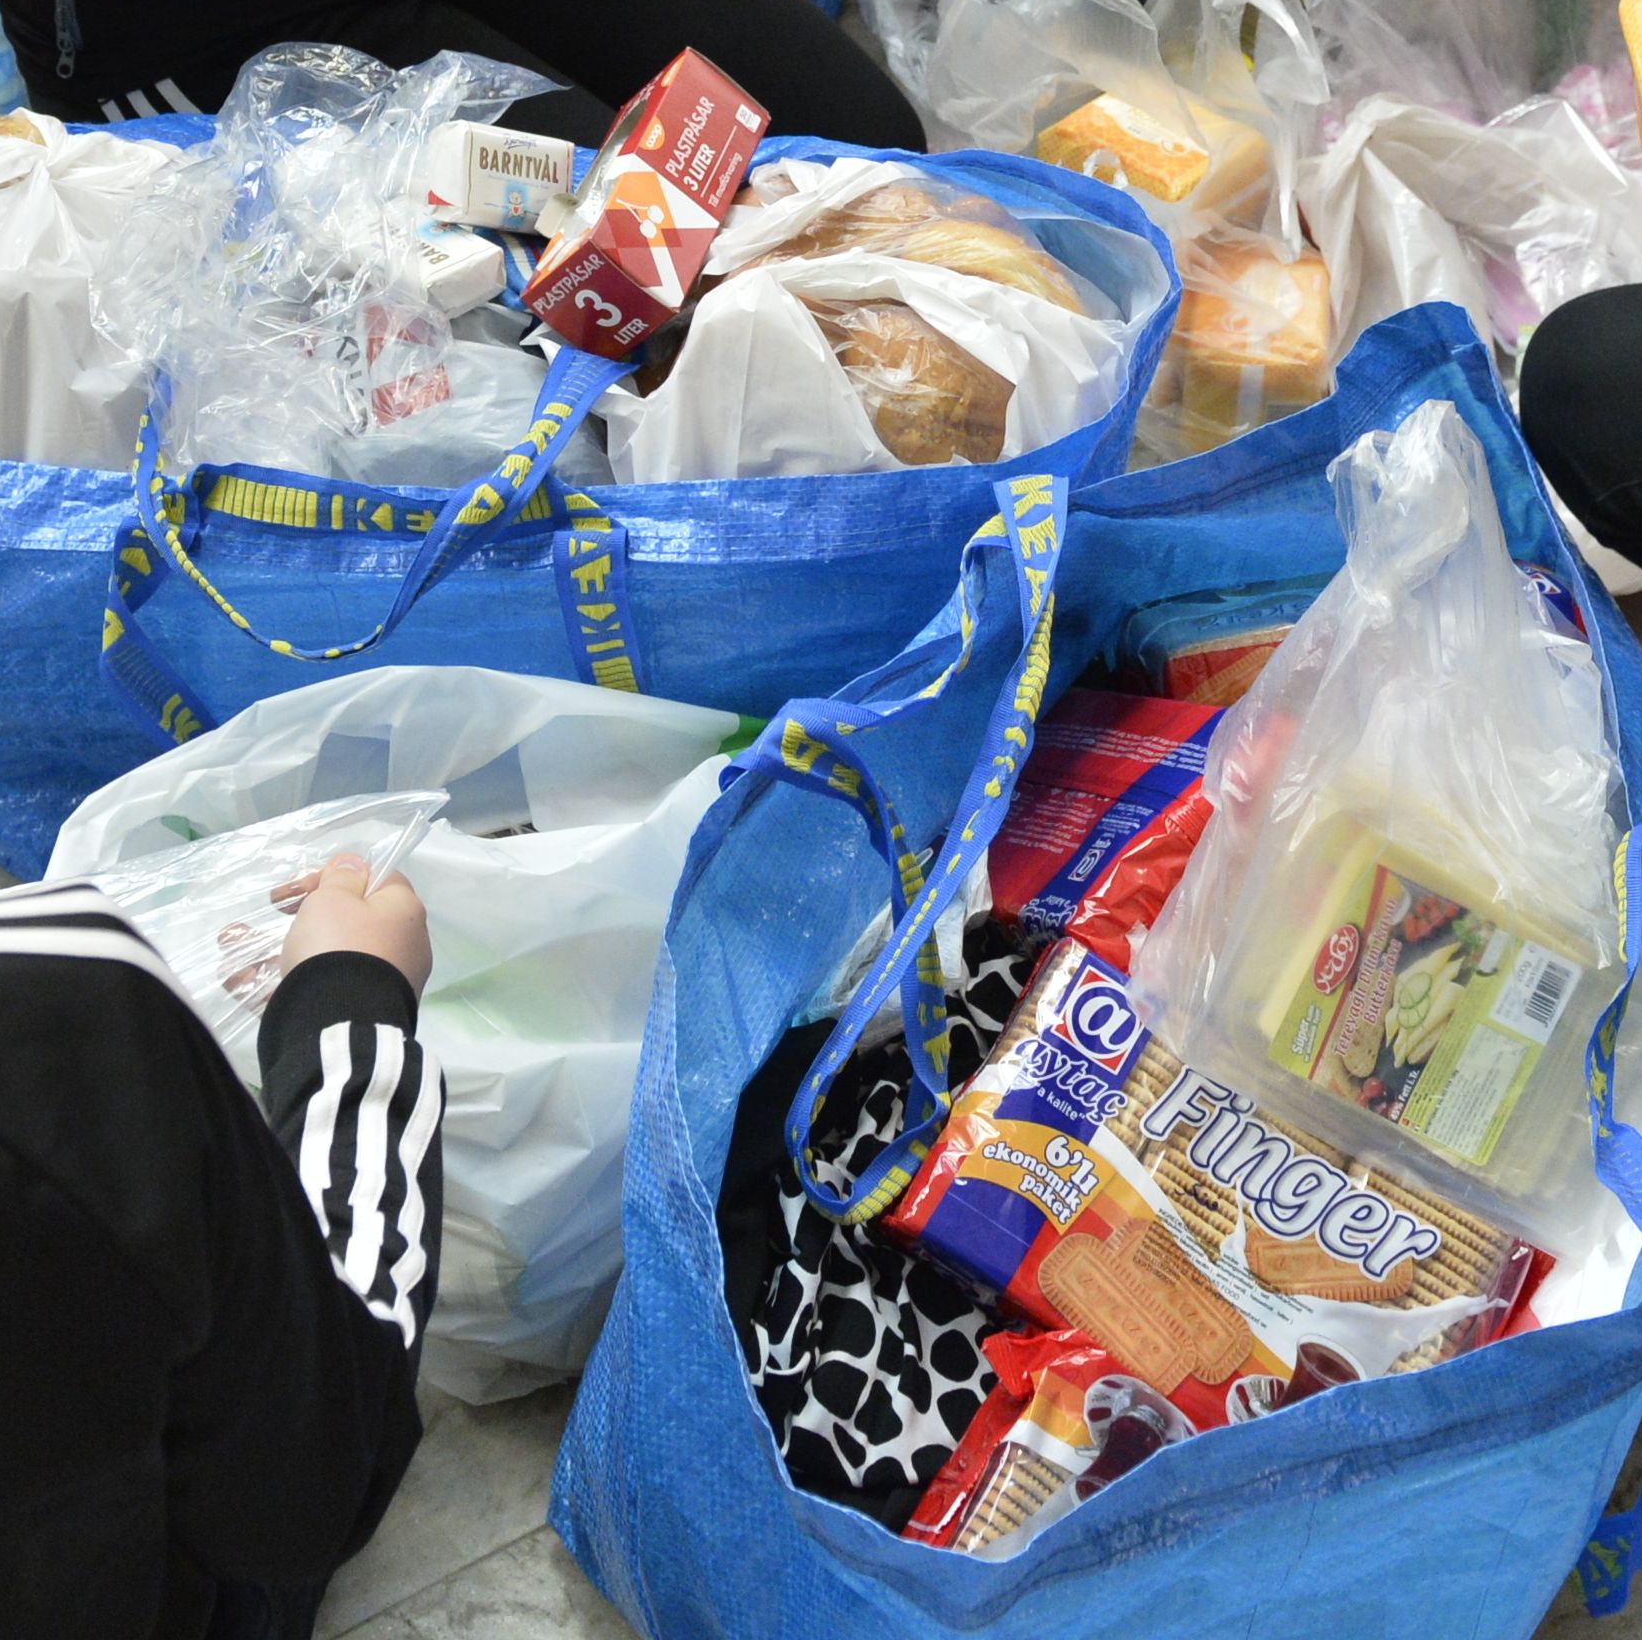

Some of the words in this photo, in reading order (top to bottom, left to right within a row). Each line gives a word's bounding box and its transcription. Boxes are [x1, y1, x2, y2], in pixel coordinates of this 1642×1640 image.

[664, 95, 715, 178] PLASTPÅSAR
[479, 146, 559, 184] BARNTVÅL
[683, 177, 699, 191] 3
[688, 143, 717, 181] LITER
[532, 253, 605, 315] PLASTPÅSAR
[574, 289, 622, 327] 3
[613, 317, 650, 345] LITER
[982, 1142, 1083, 1211] ekonomik
[1139, 1066, 1438, 1282] Finger
[1020, 1173, 1072, 1225] paket
